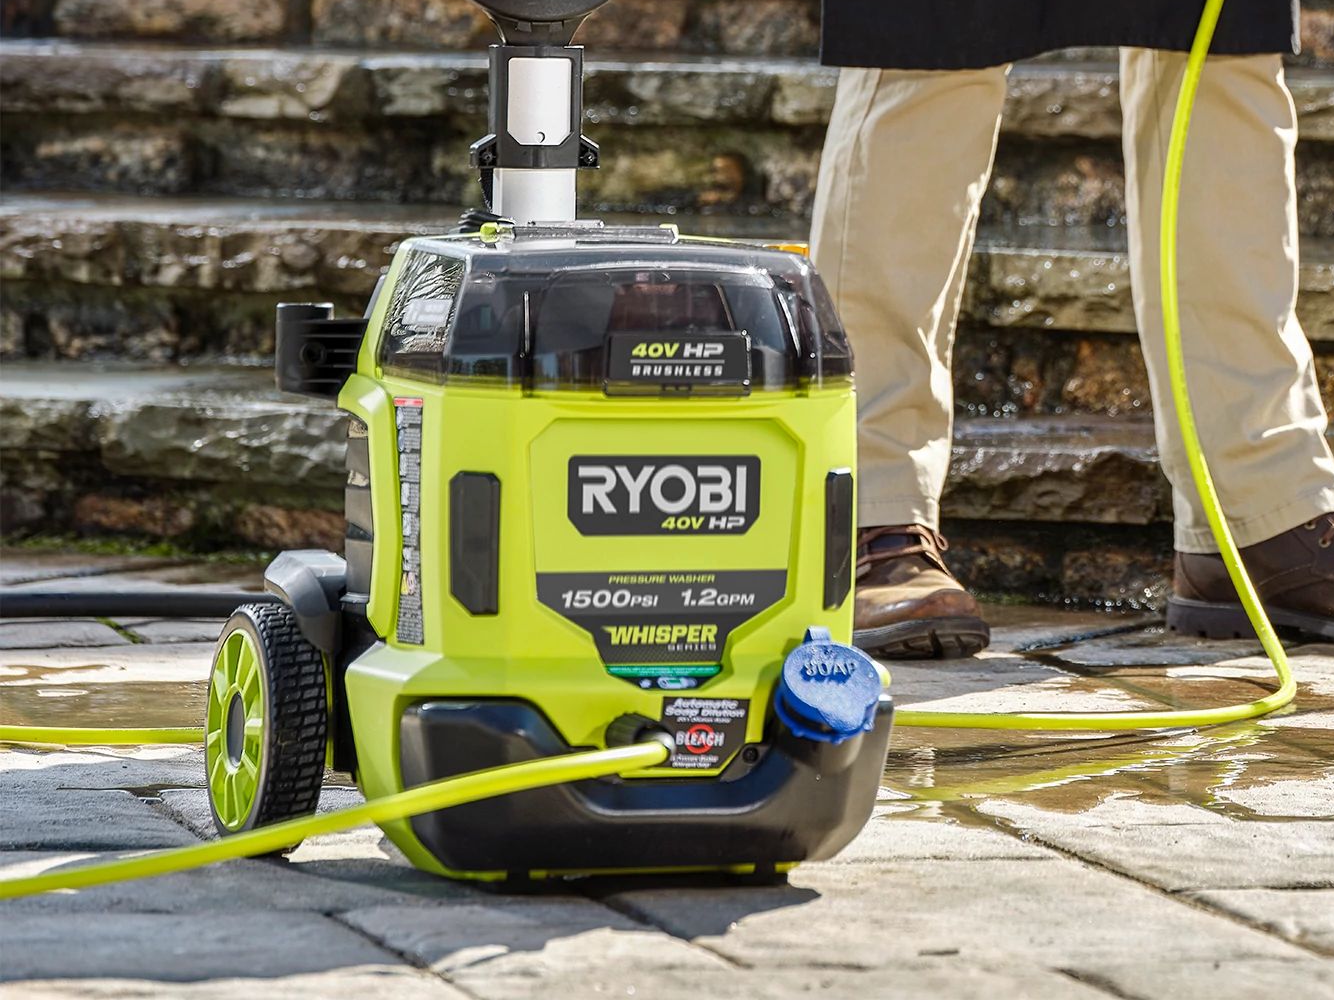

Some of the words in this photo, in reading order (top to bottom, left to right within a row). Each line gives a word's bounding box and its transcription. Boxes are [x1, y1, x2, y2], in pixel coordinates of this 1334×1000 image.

[631, 342, 680, 358] 40V
[682, 342, 724, 358] HP
[631, 365, 723, 377] BRUSHLESS
[578, 464, 747, 514] RYOBI
[660, 516, 705, 530] 40V
[708, 516, 746, 530] HP
[608, 575, 666, 585] PRESSURE
[669, 574, 716, 584] WASHER
[602, 624, 718, 645] WHISPER
[803, 660, 858, 677] SOAP
[673, 698, 739, 709] Automatic
[664, 705, 699, 718] Soap
[701, 708, 746, 718] Dilution
[675, 730, 725, 747] BLEACH
